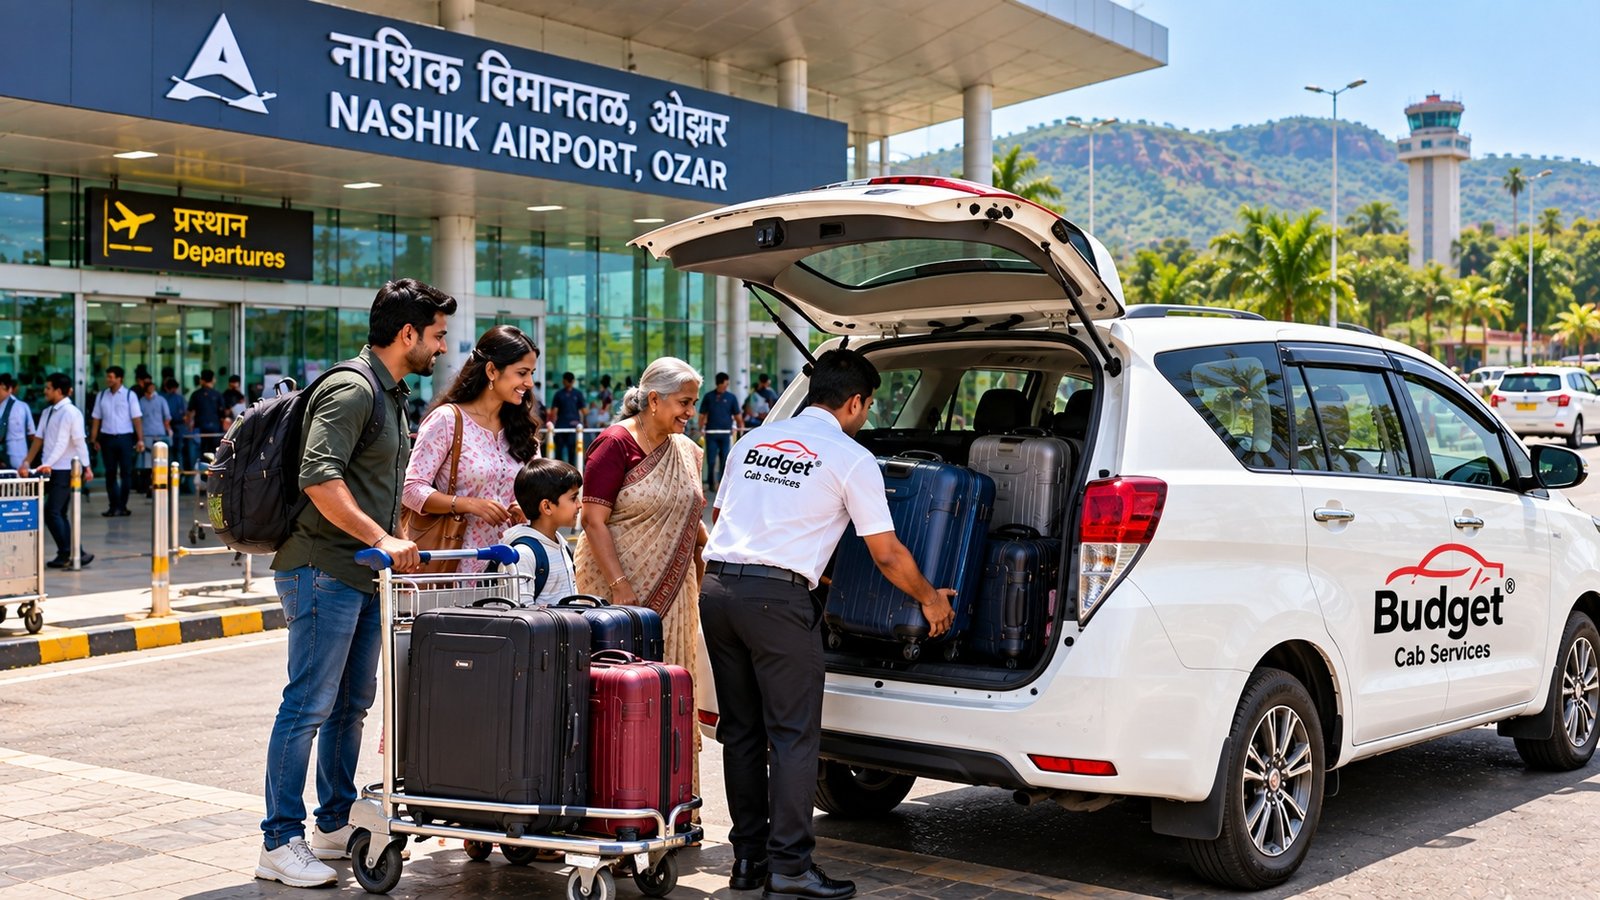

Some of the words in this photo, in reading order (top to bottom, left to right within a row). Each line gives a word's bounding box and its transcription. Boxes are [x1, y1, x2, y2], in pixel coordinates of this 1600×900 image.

[329, 26, 463, 94] नाशिक
[477, 49, 637, 135] विमानतळ,
[329, 91, 480, 152] NASHIK
[493, 122, 643, 183] AIRPORT,
[652, 150, 728, 191] OZAR
[173, 207, 248, 238] प्रस्थान
[173, 238, 285, 268] Departures
[744, 470, 761, 480] Cab
[763, 473, 800, 488] Services
[1394, 645, 1425, 667] Cab
[1430, 641, 1490, 664] Services
